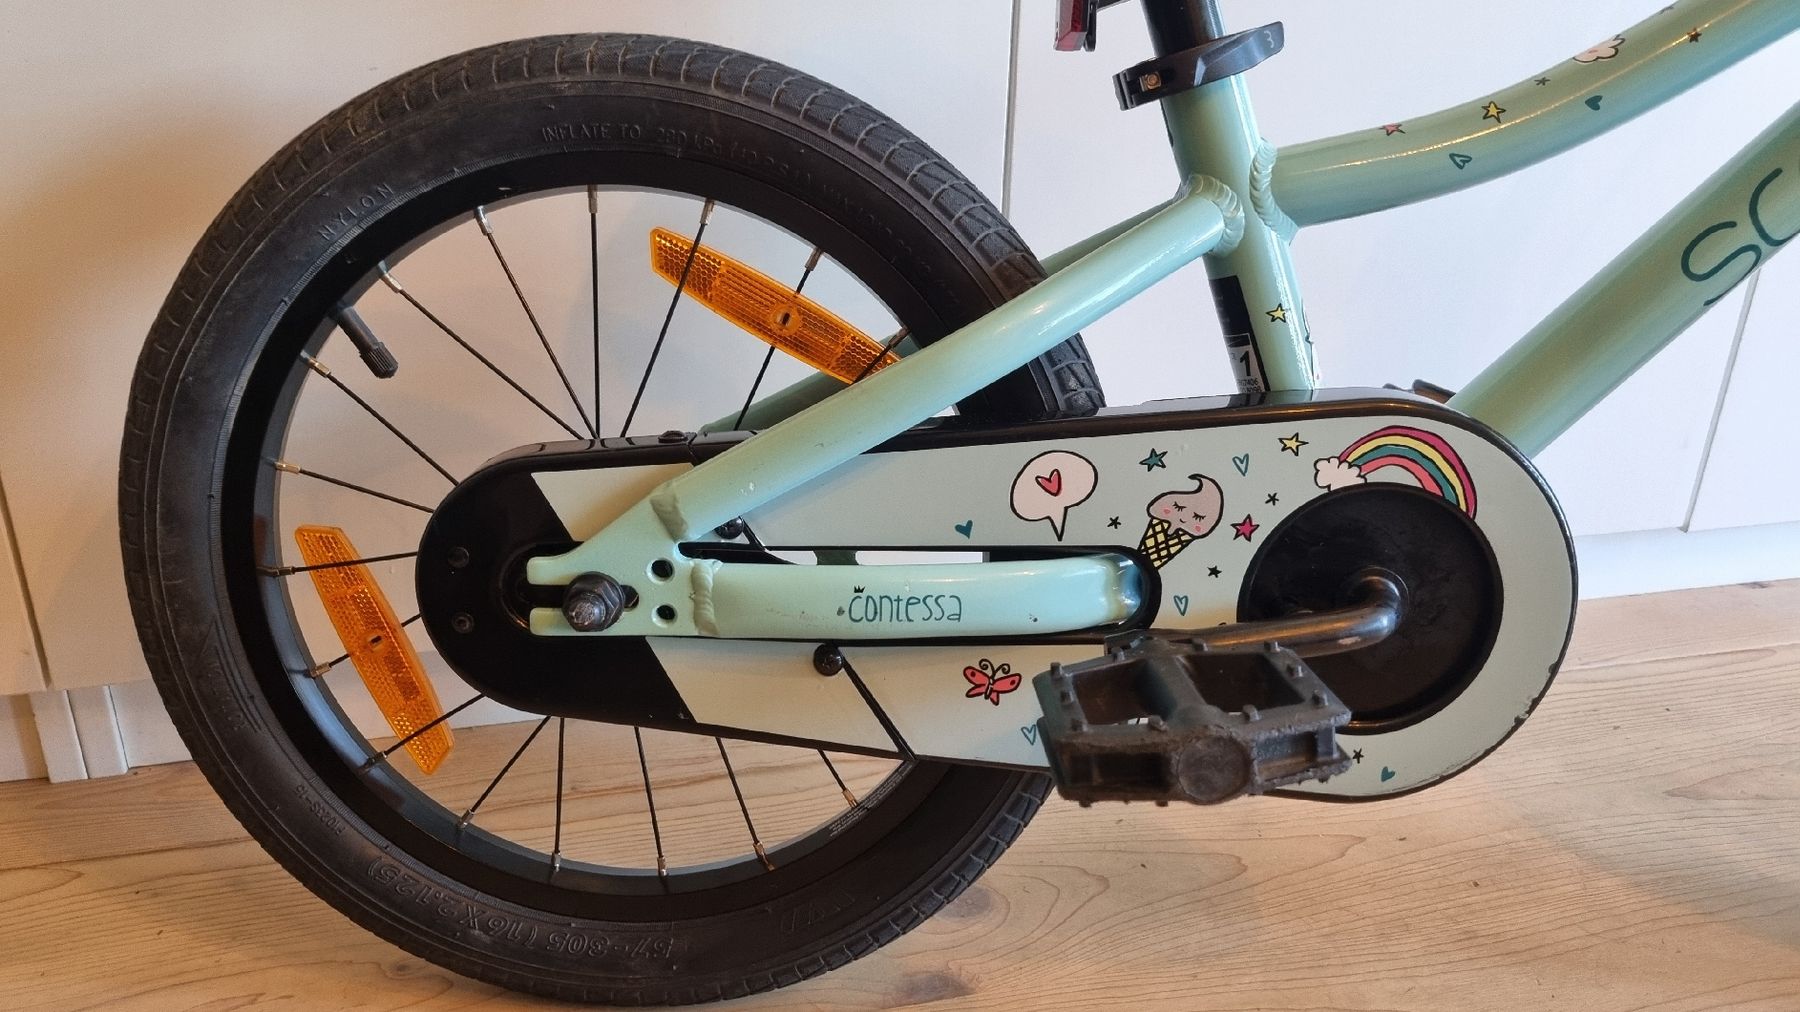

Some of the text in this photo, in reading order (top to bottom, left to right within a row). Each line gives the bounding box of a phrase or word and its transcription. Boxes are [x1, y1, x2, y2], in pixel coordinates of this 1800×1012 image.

[541, 123, 611, 142] INFLATE
[618, 123, 641, 139] TO
[317, 182, 394, 240] NYLON
[1239, 350, 1252, 377] 1
[848, 594, 962, 623] contessa
